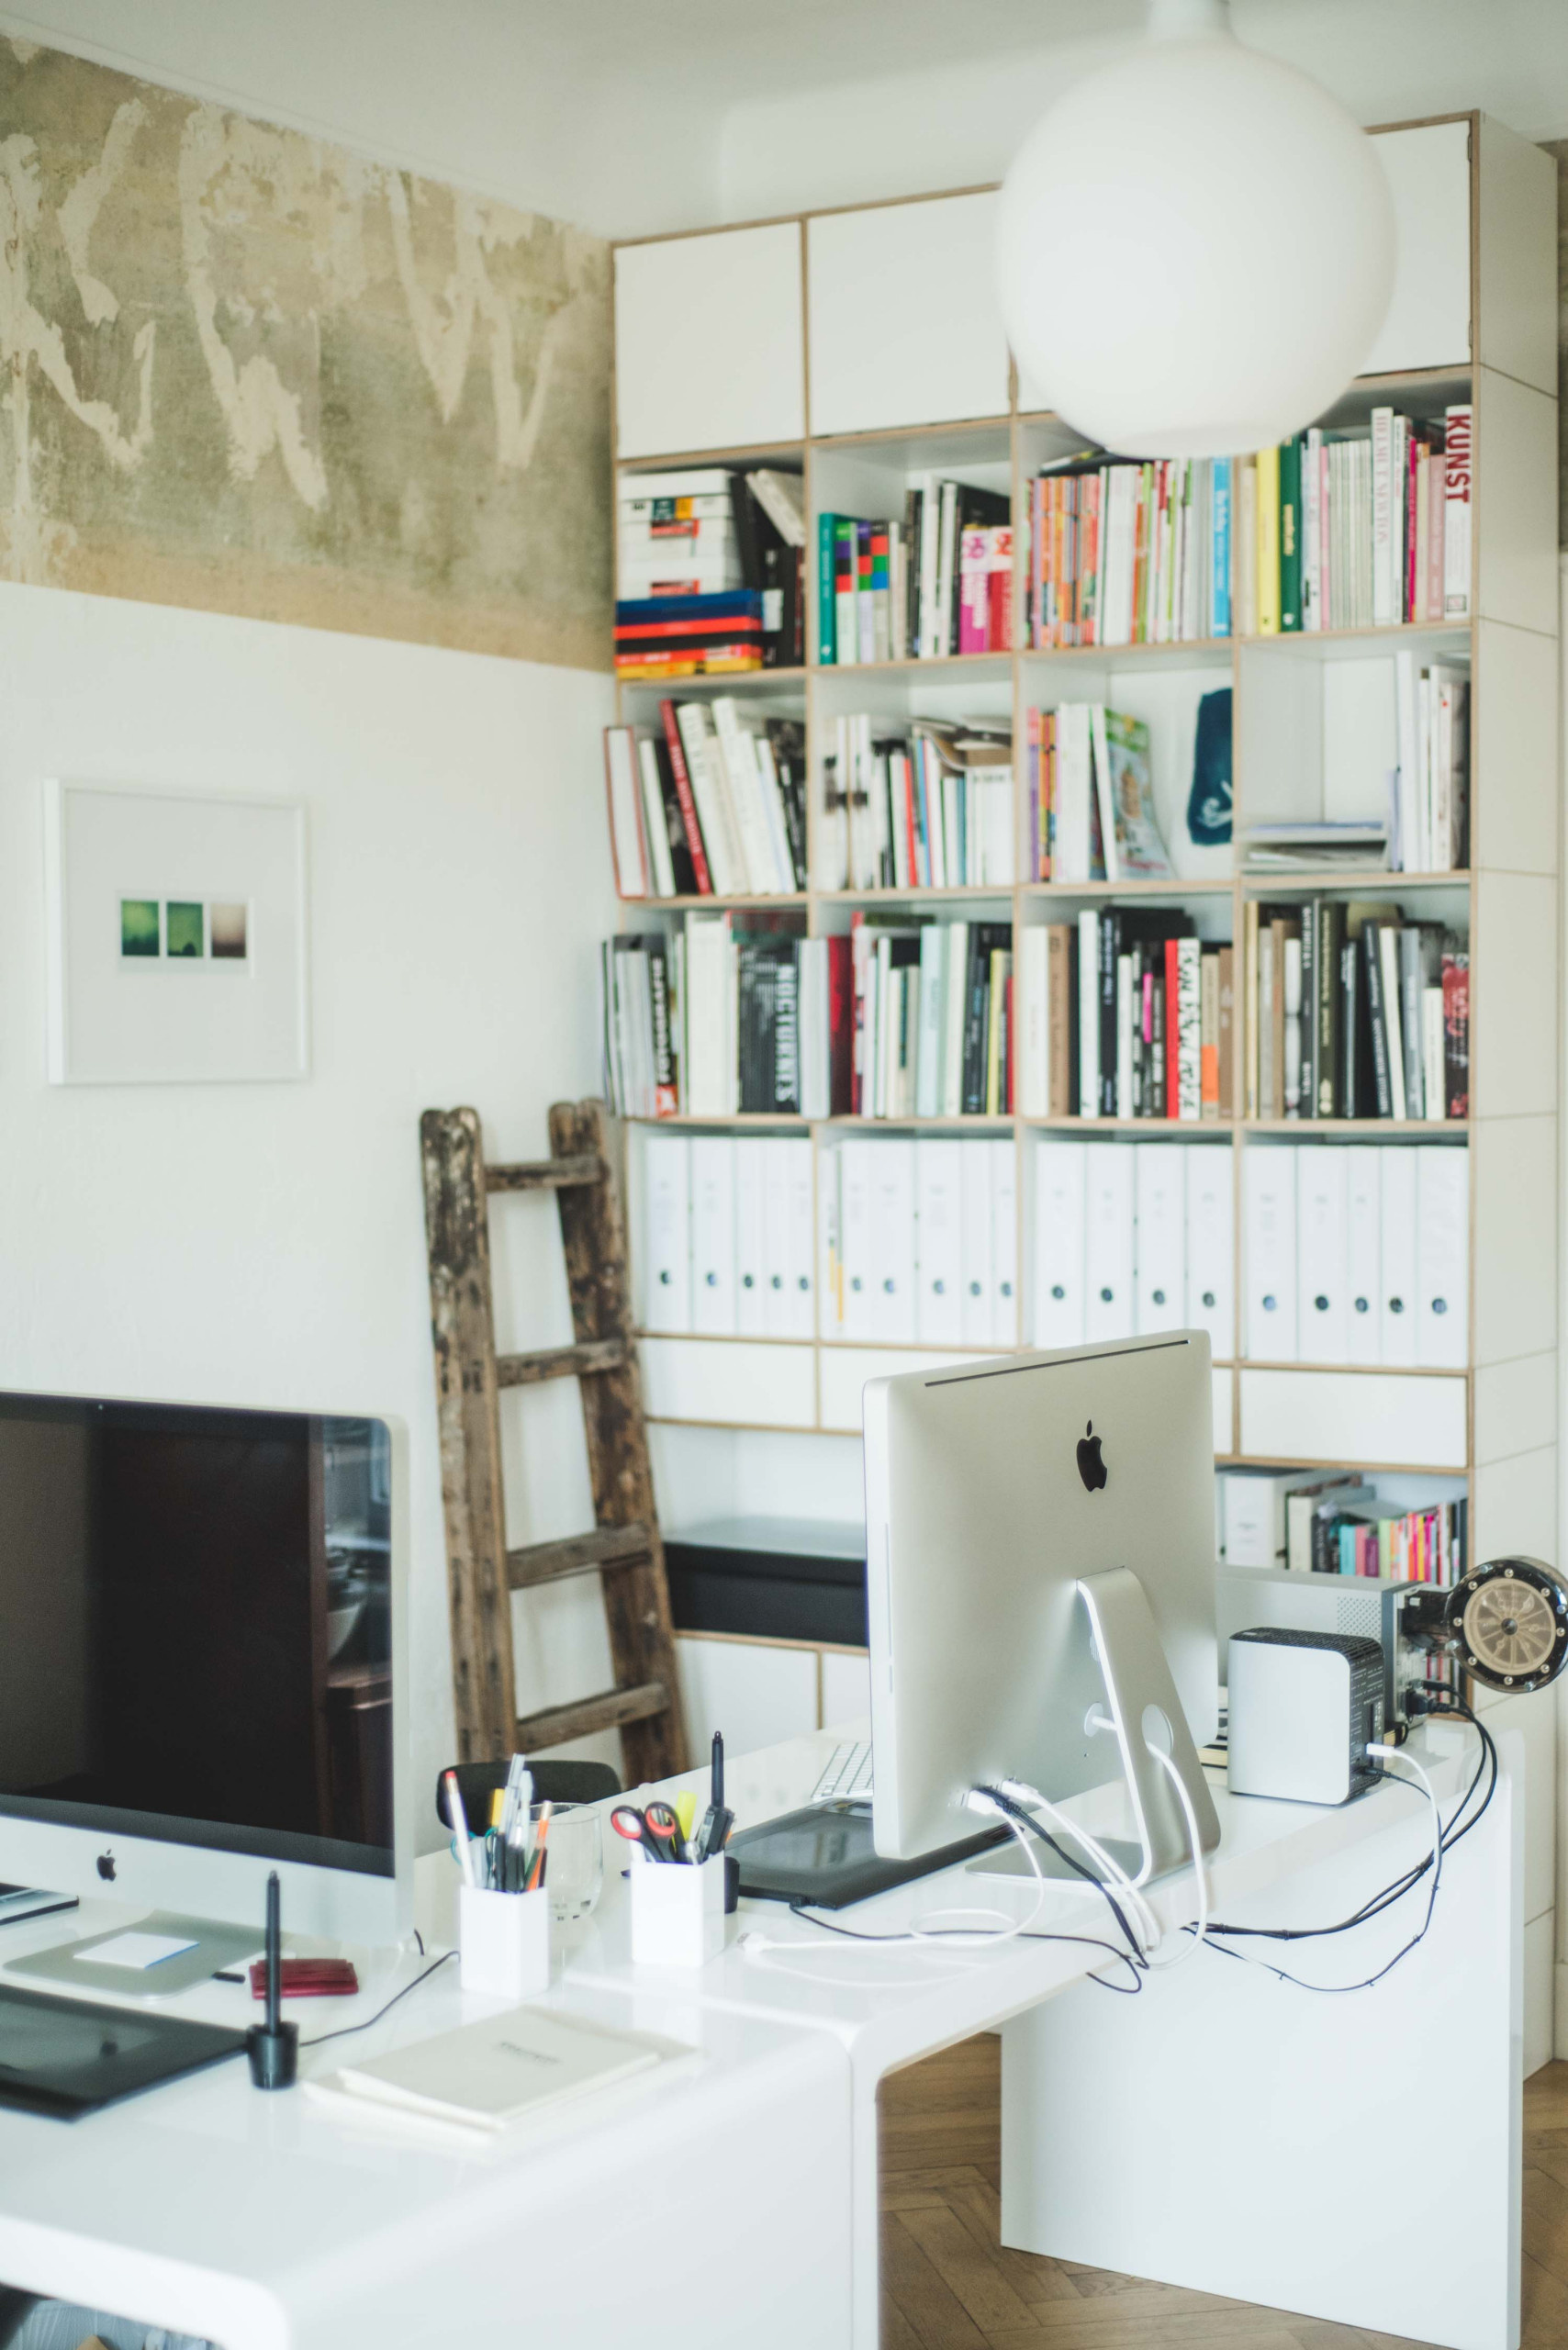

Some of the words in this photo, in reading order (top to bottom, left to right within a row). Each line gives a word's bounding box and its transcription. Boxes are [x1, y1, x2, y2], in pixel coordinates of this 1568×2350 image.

[1375, 416, 1390, 476] HELMUT
[1446, 414, 1472, 503] KUNST
[1375, 482, 1390, 543] NEWTON
[776, 964, 798, 1102] NOCTURNES
